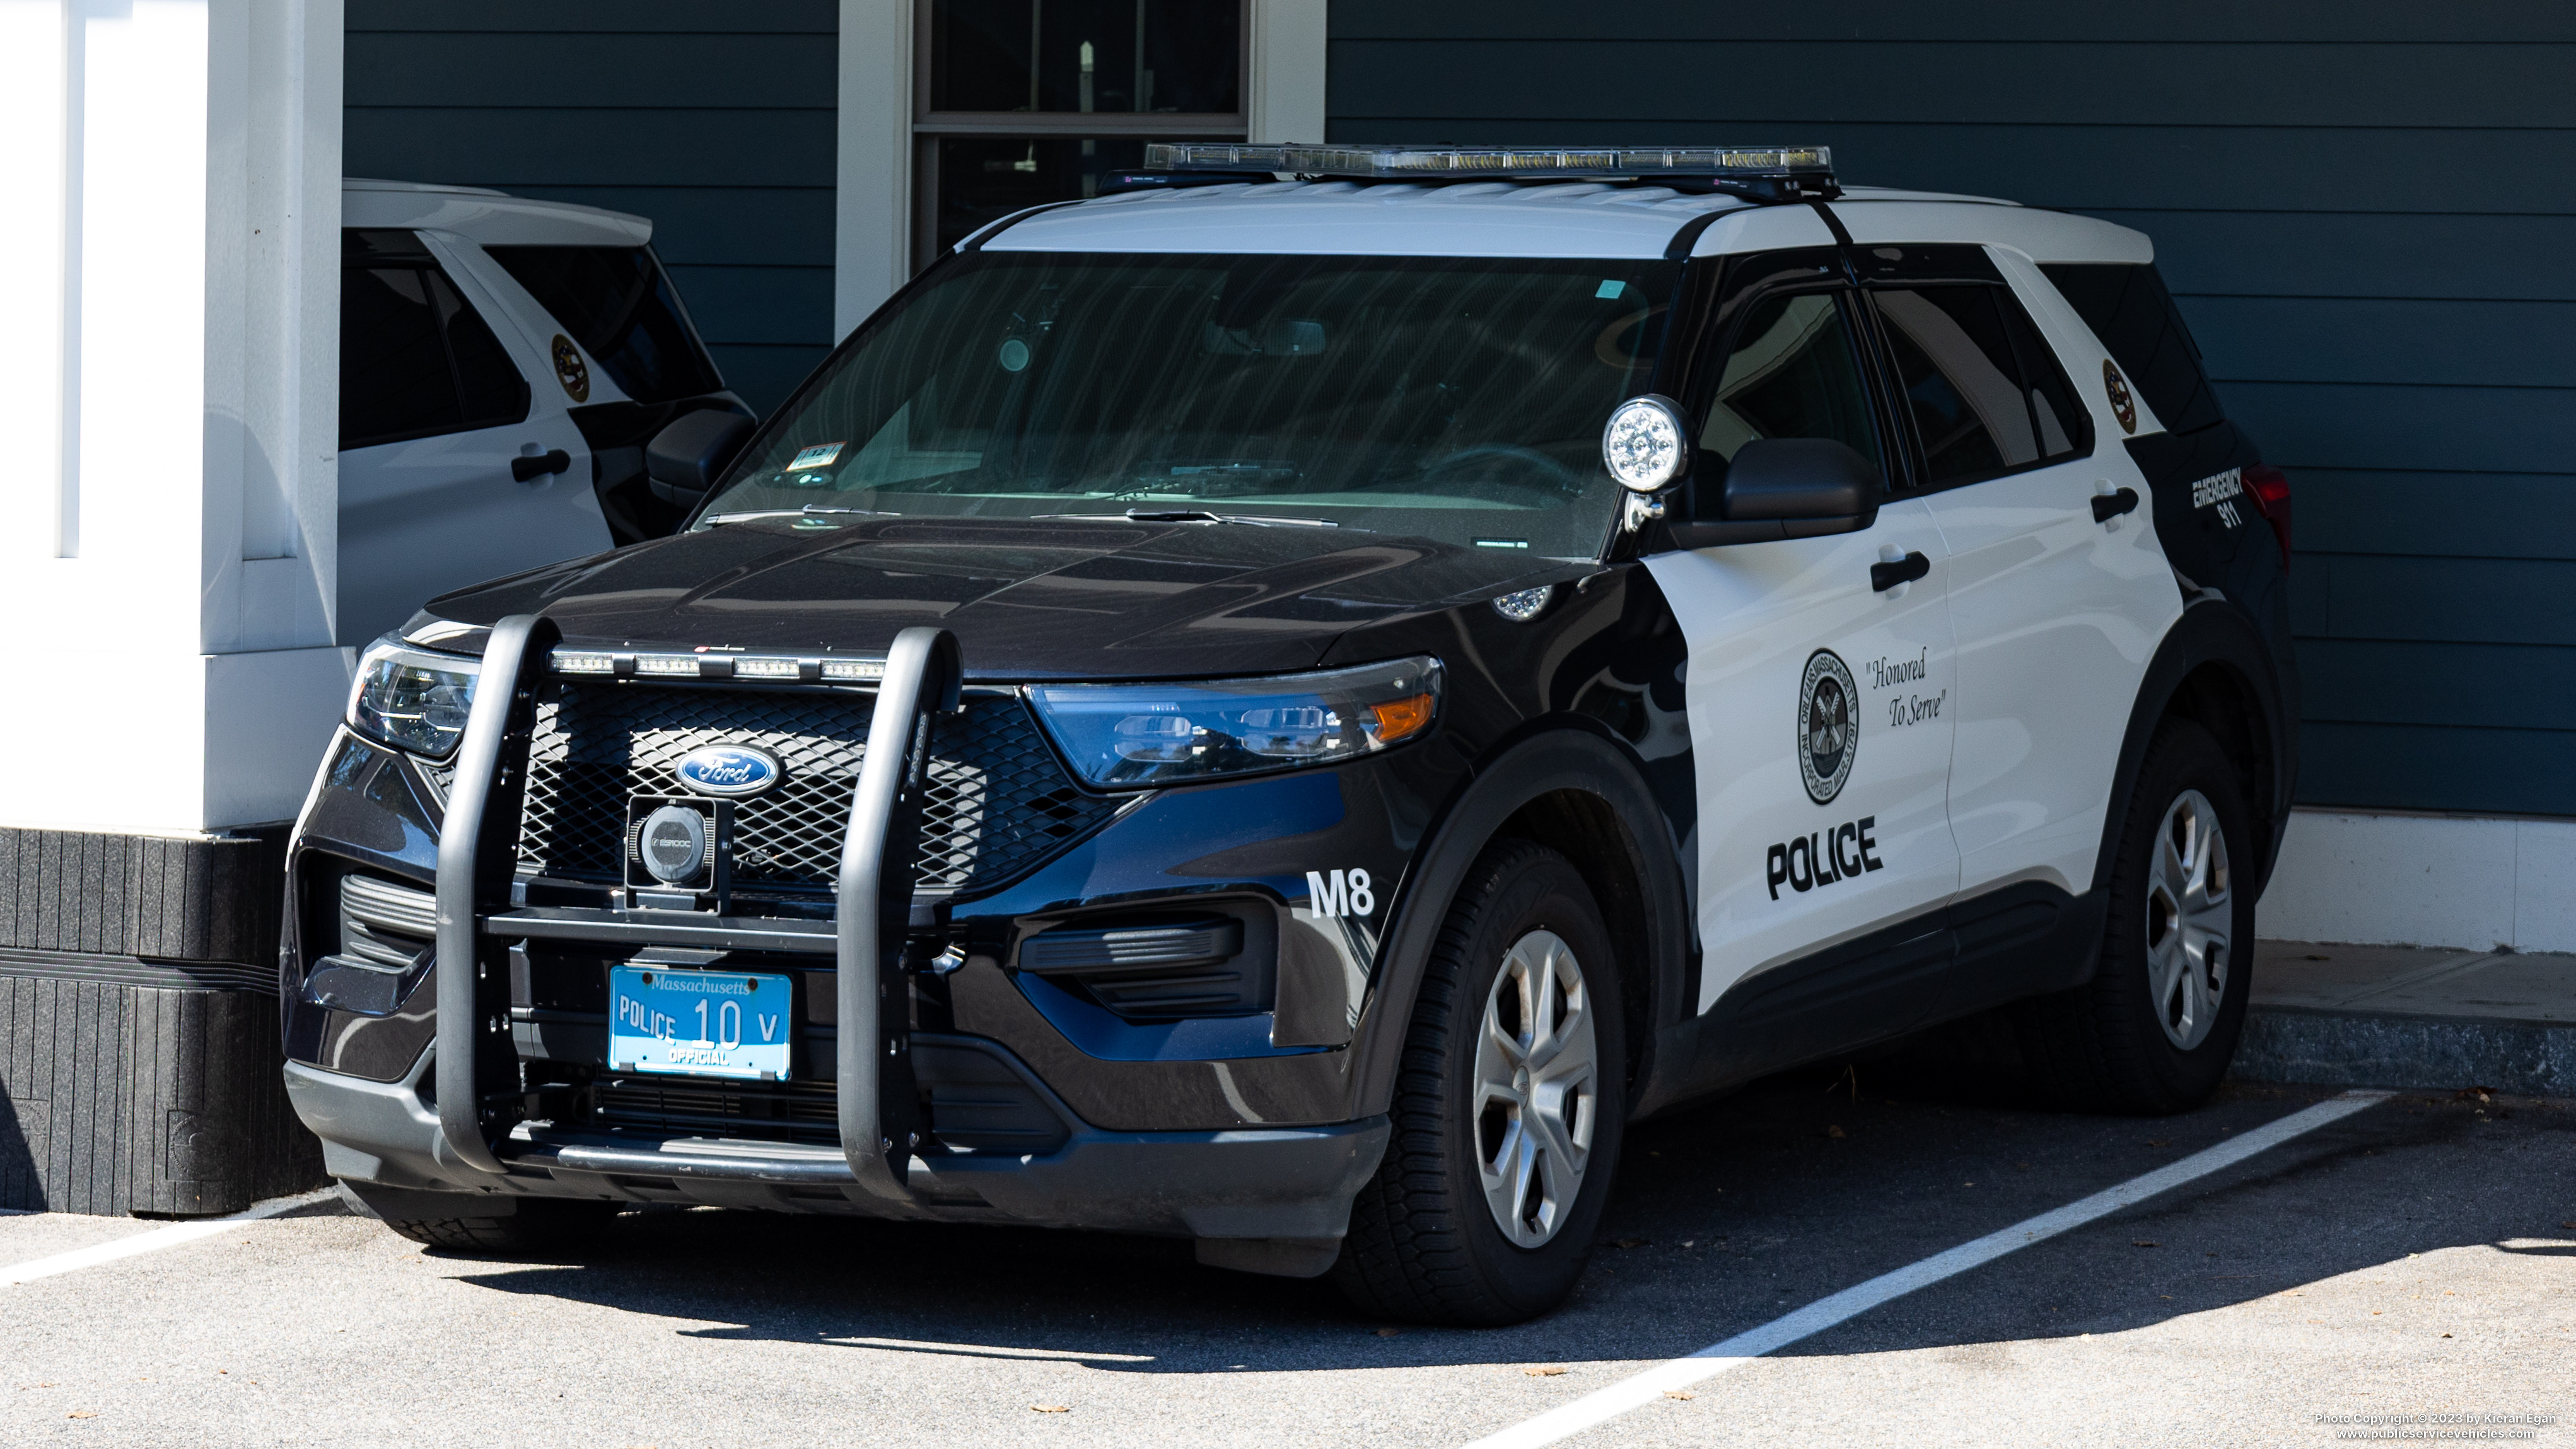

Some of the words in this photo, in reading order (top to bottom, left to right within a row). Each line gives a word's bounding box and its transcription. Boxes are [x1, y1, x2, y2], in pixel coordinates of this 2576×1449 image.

[811, 448, 827, 457] 12
[2193, 467, 2242, 508] EMERGENCY
[2217, 500, 2241, 528] 911
[1812, 656, 1856, 713] MASSACHUSETTS
[1866, 646, 1926, 689] "Honored
[1889, 694, 1905, 726] To
[1907, 688, 1946, 726] Serve"
[698, 756, 752, 782] Ford
[1801, 733, 1833, 796] INCORPORATED
[1767, 815, 1884, 900] POLICE
[1306, 868, 1374, 918] M8
[651, 974, 750, 996] Massachusetts
[619, 994, 676, 1046] POLICE
[692, 999, 741, 1050] 10
[758, 1013, 778, 1042] V
[668, 1048, 730, 1066] OFFICIAL
